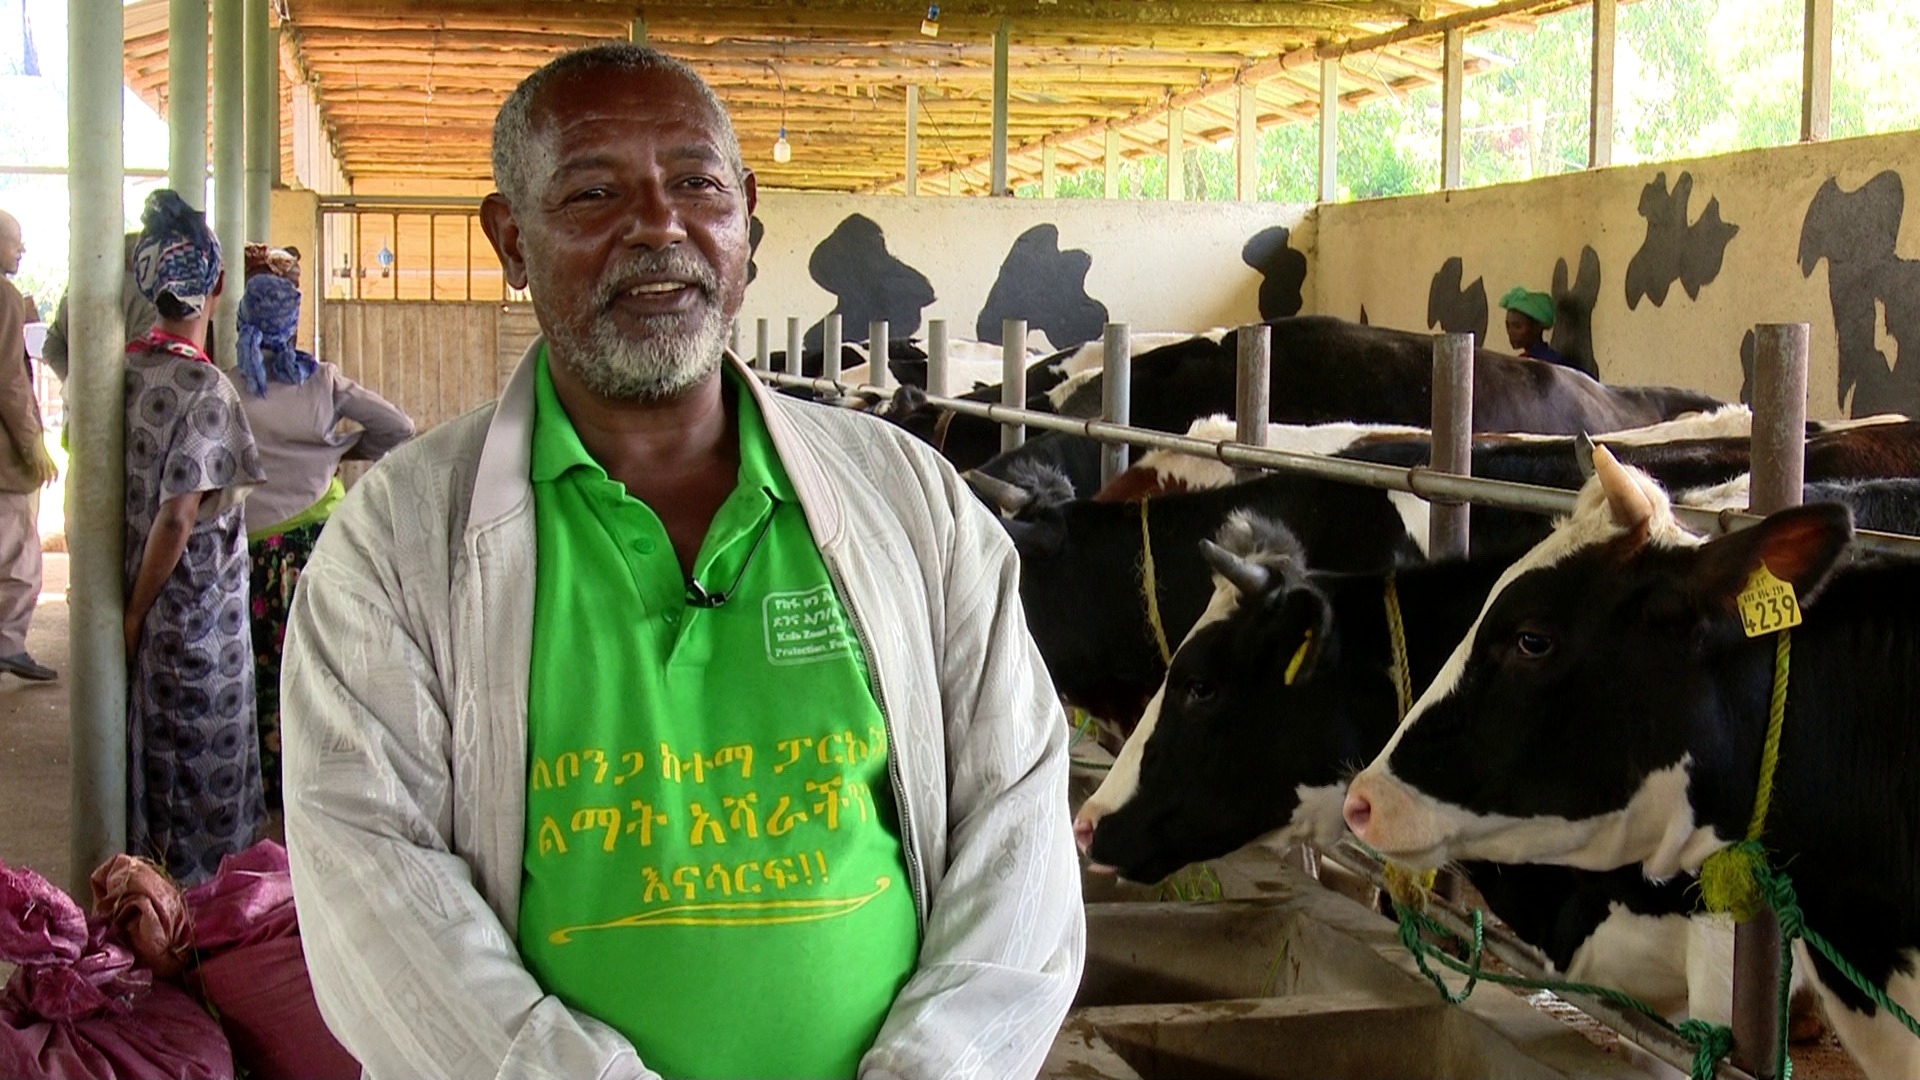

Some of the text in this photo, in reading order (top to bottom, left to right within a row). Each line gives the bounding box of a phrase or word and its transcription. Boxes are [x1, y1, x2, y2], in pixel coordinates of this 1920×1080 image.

[1741, 595, 1794, 632] 4239
[532, 747, 645, 792] ለቦንጋ
[660, 742, 754, 784] ከተማ
[538, 799, 670, 858] ልማት
[641, 849, 830, 905] እናሳርፍ!!
